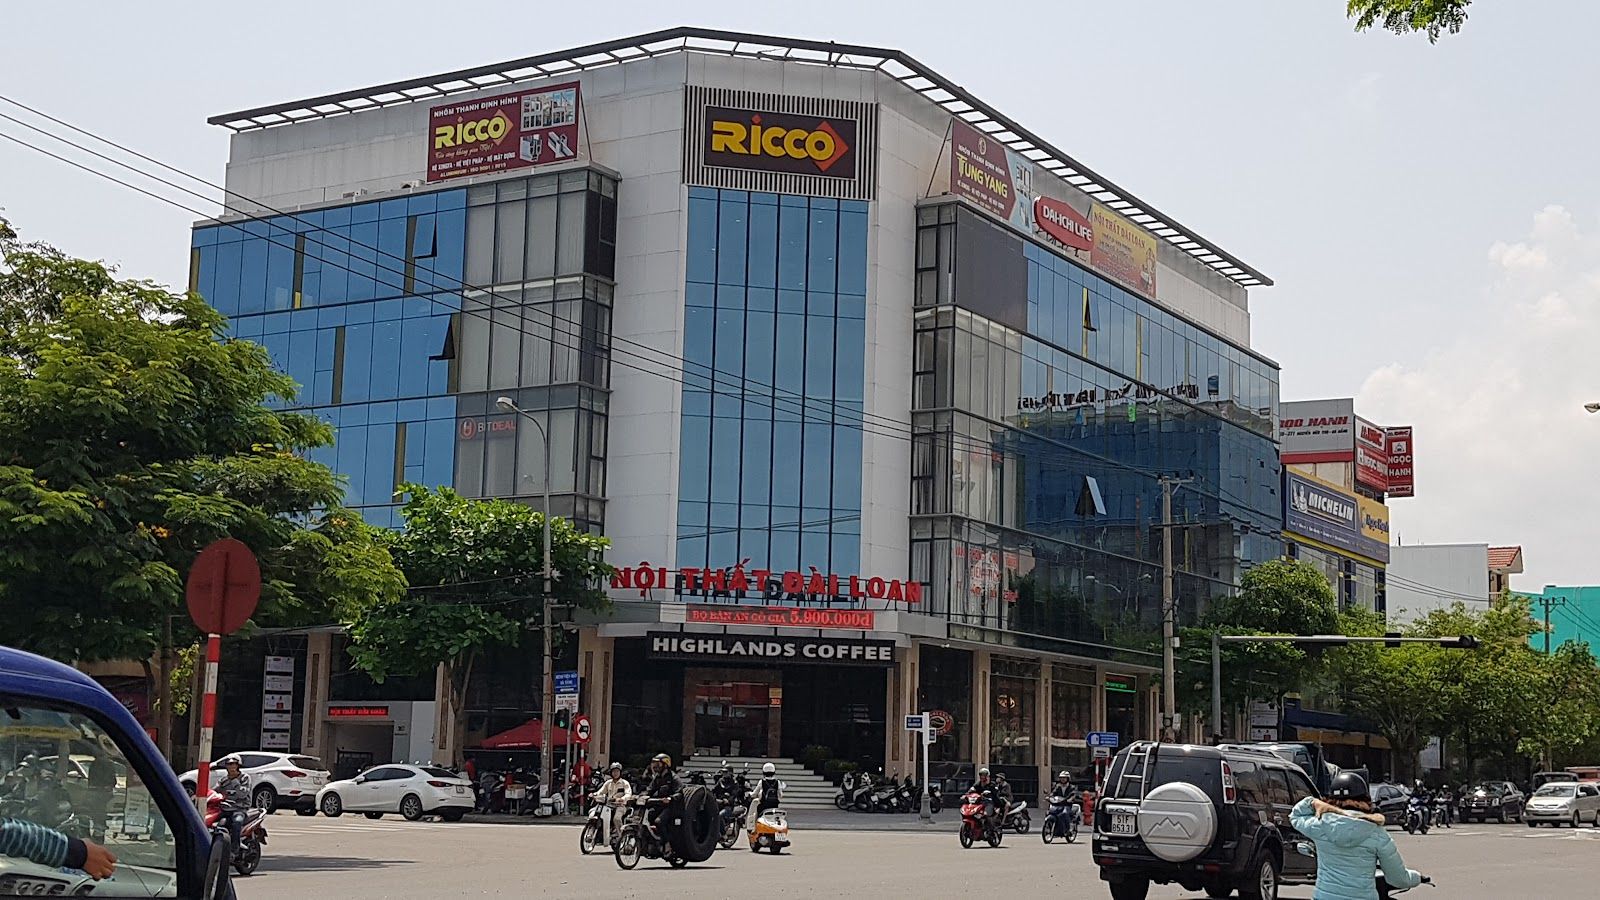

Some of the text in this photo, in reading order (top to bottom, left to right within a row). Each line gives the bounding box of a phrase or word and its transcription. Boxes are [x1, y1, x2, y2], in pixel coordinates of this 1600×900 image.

[456, 104, 480, 114] THANH
[1074, 222, 1092, 242] LIFE
[1388, 456, 1412, 465] NGỌC
[1389, 468, 1412, 478] HẠNH
[1308, 491, 1354, 521] MICHELIN
[610, 558, 922, 603] NỘI THẤT ĐÀI LOAN
[652, 637, 892, 661] HIGHLANDS COFFEE
[1117, 814, 1129, 824] 51F
